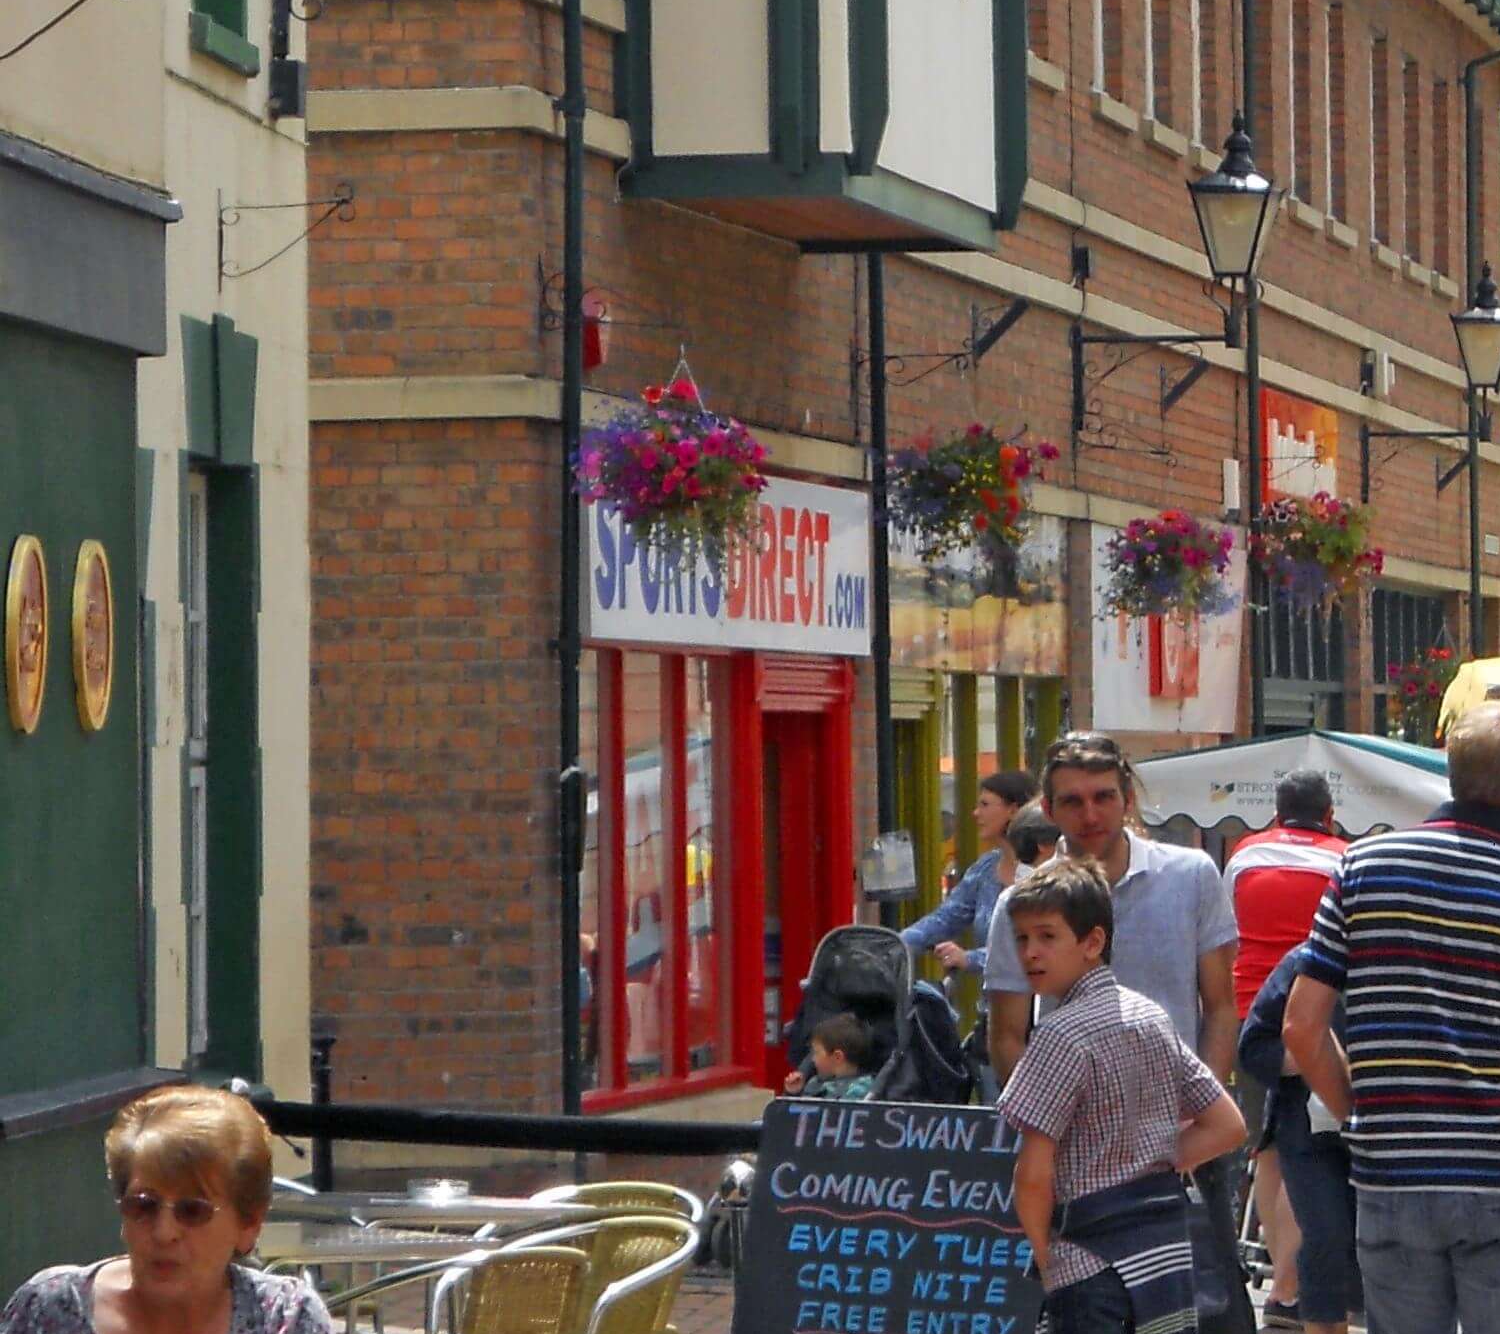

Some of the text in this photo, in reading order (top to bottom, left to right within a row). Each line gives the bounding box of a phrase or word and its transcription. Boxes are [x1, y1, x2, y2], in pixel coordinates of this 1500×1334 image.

[788, 1104, 869, 1149] THE
[875, 1107, 980, 1152] SWAN
[770, 1161, 1016, 1213] COMING EVEN
[787, 1223, 919, 1260] EVERY
[796, 1263, 1008, 1304] CRIB NITE
[796, 1301, 889, 1334] FREE
